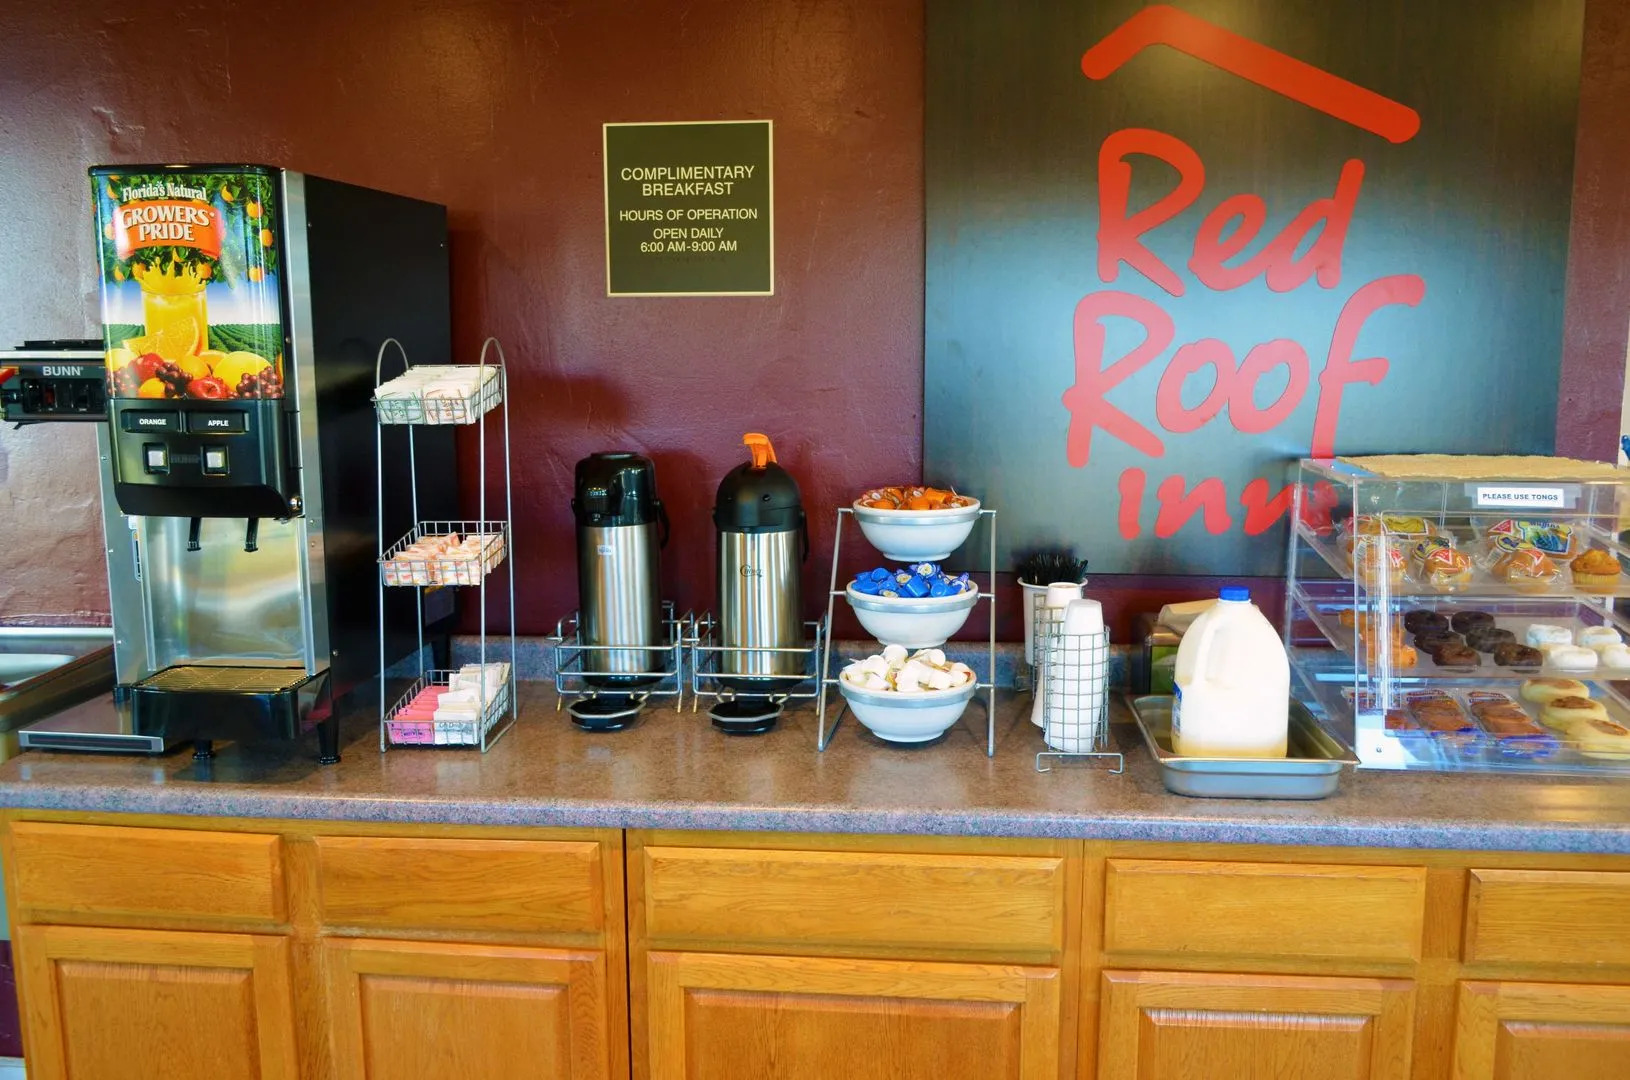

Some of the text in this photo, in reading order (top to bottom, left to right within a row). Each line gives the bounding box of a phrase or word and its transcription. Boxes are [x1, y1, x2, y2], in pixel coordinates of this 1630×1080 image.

[620, 165, 755, 181] COMPLIMENTARY
[122, 182, 207, 202] Florida's Natural
[642, 181, 734, 197] BREAKFAST
[619, 208, 758, 221] HOURS OF OPERATION
[1096, 127, 1366, 297] Red
[138, 222, 195, 242] PRIDE
[653, 227, 724, 240] OPEN DAILY
[640, 241, 664, 253] 6:00
[718, 240, 737, 252] AM
[42, 366, 81, 377] BUNN
[1061, 274, 1427, 468] Roof
[138, 418, 167, 426] ORANGE
[207, 419, 229, 427] APPLE
